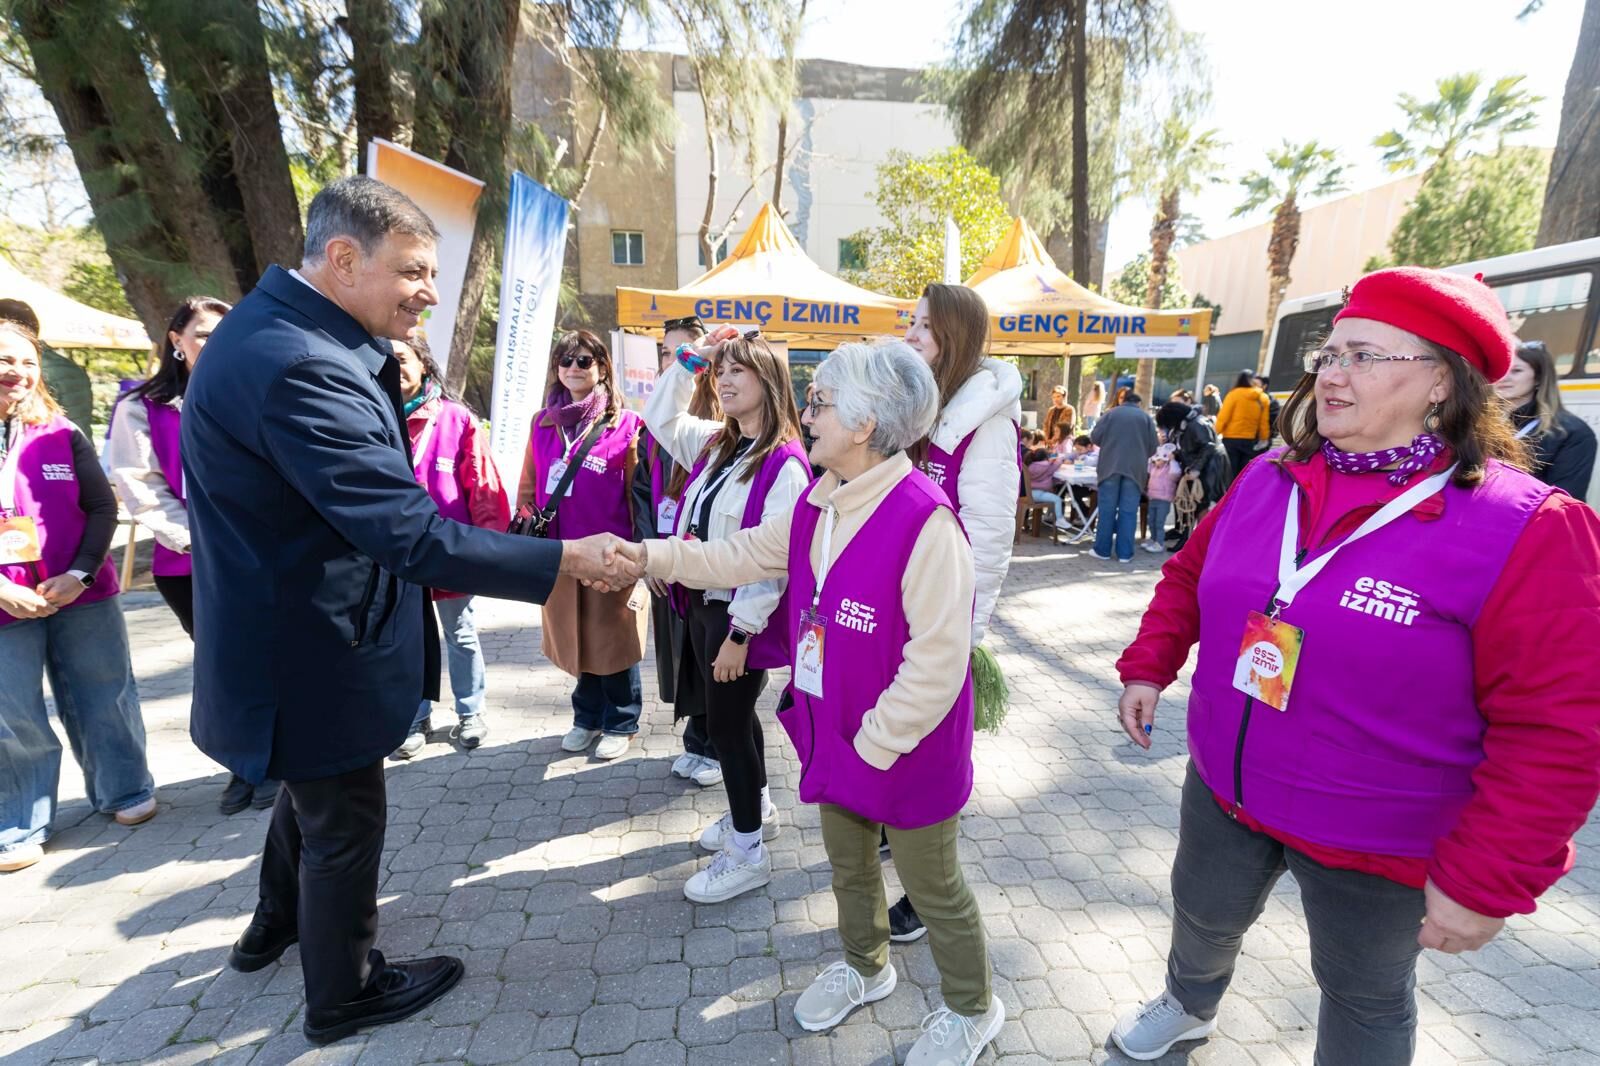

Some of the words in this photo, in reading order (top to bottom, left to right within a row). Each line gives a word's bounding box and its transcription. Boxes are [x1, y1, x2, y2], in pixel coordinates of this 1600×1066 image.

[694, 299, 772, 326] GENÇ
[1000, 314, 1069, 338] GENÇ
[1339, 590, 1421, 626] izmir
[835, 610, 878, 634] izmir
[1252, 656, 1280, 673] izmir
